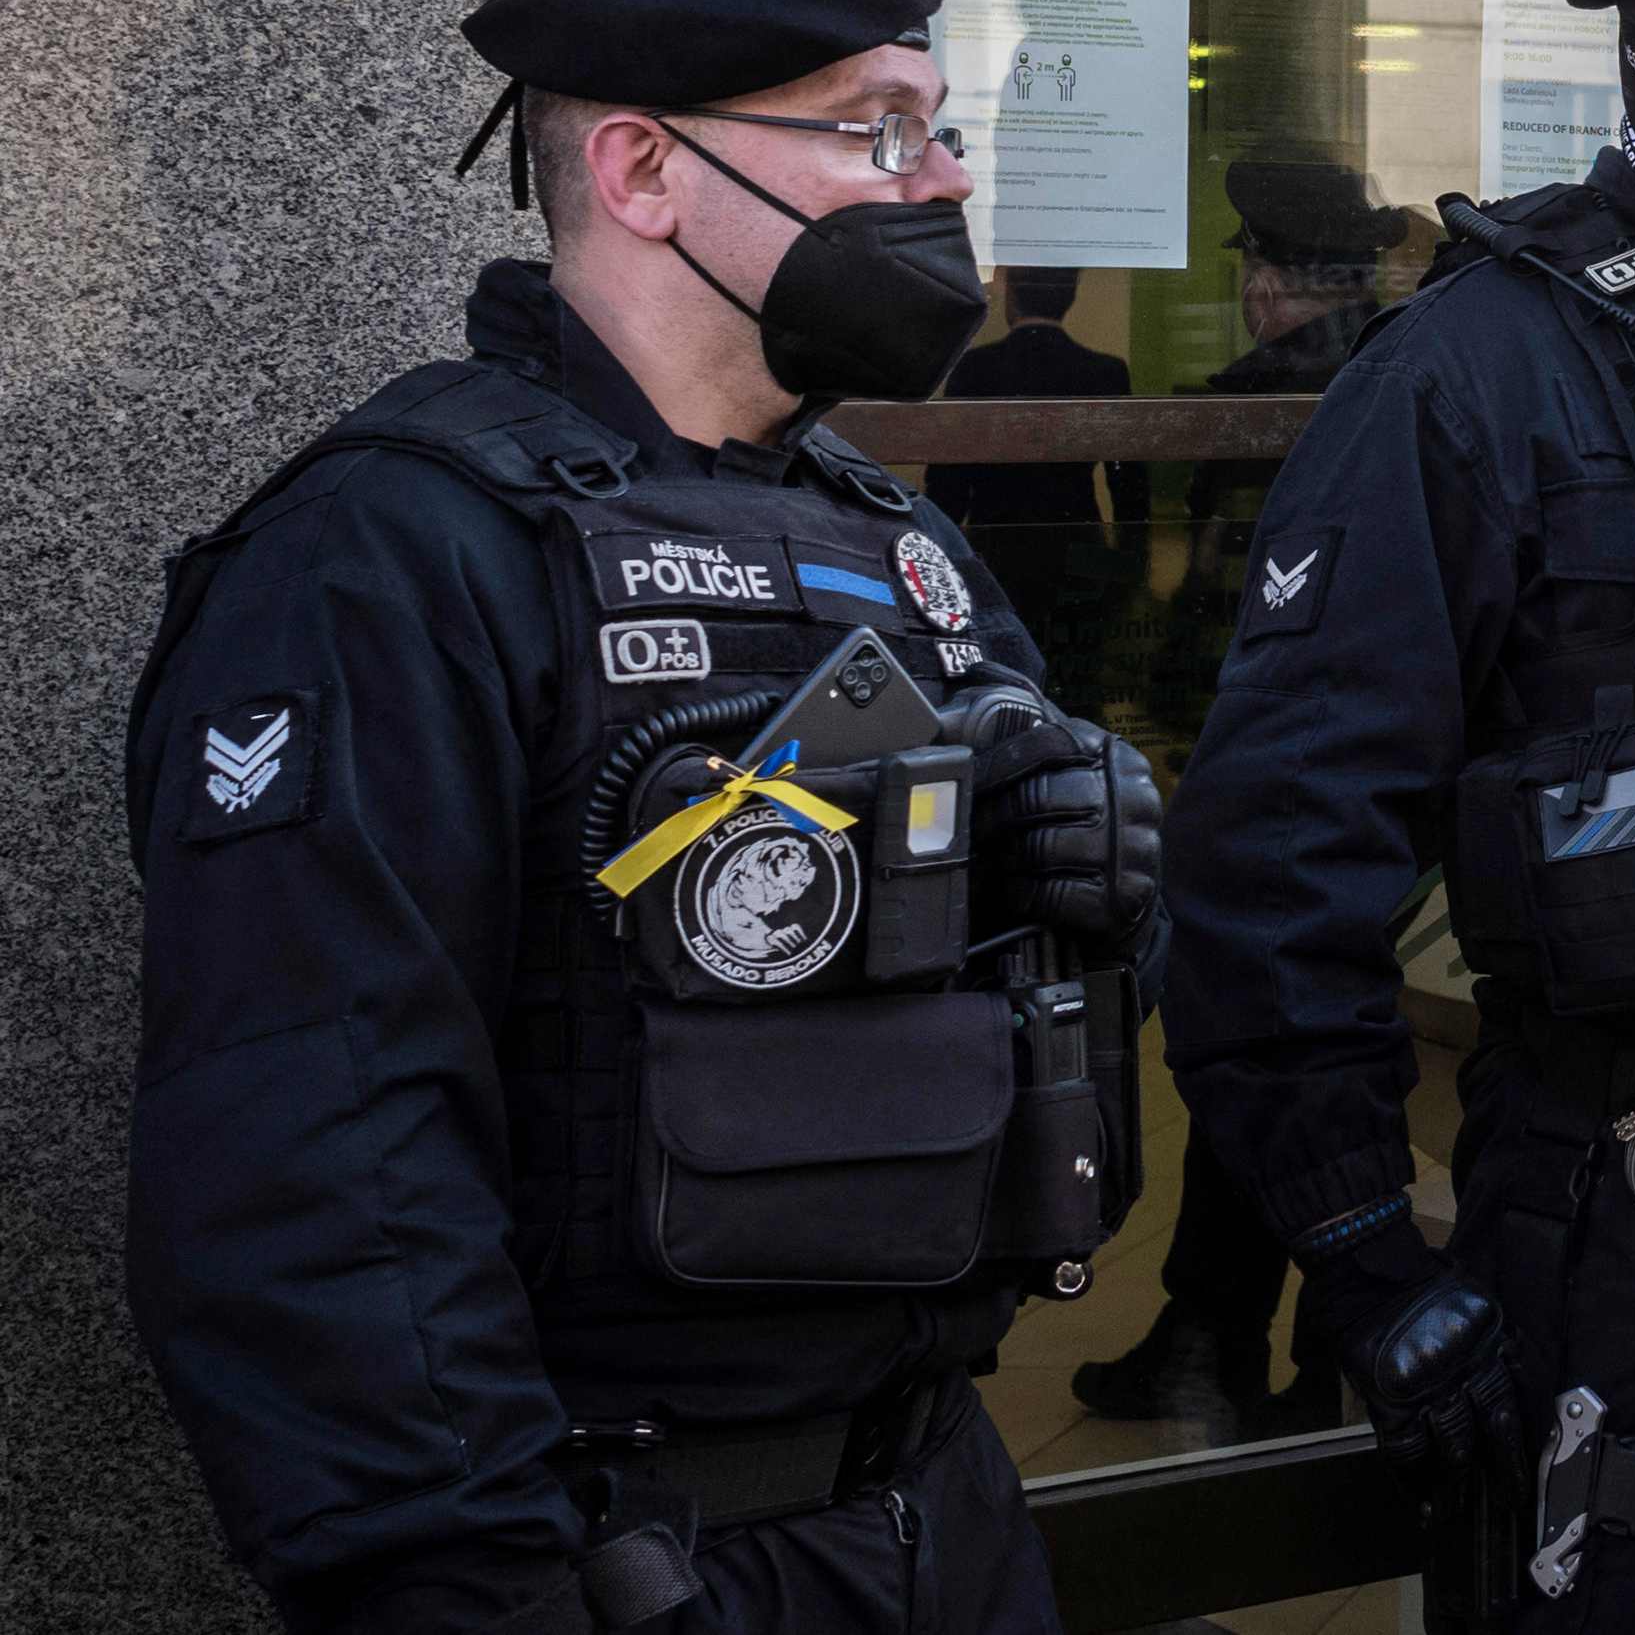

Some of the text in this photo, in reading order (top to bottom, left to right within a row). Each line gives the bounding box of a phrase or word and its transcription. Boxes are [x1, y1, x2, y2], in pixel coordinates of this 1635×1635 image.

[1036, 61, 1055, 72] 2 m
[1502, 120, 1551, 134] REDUCED
[1552, 123, 1567, 134] OF
[1569, 124, 1611, 137] BRANCH
[650, 539, 732, 564] MĚSTSKÁ
[620, 558, 776, 601] POLICIE
[659, 652, 701, 669] POS
[722, 808, 786, 836] POLIC
[691, 933, 833, 984] MUSADO BEROUN
